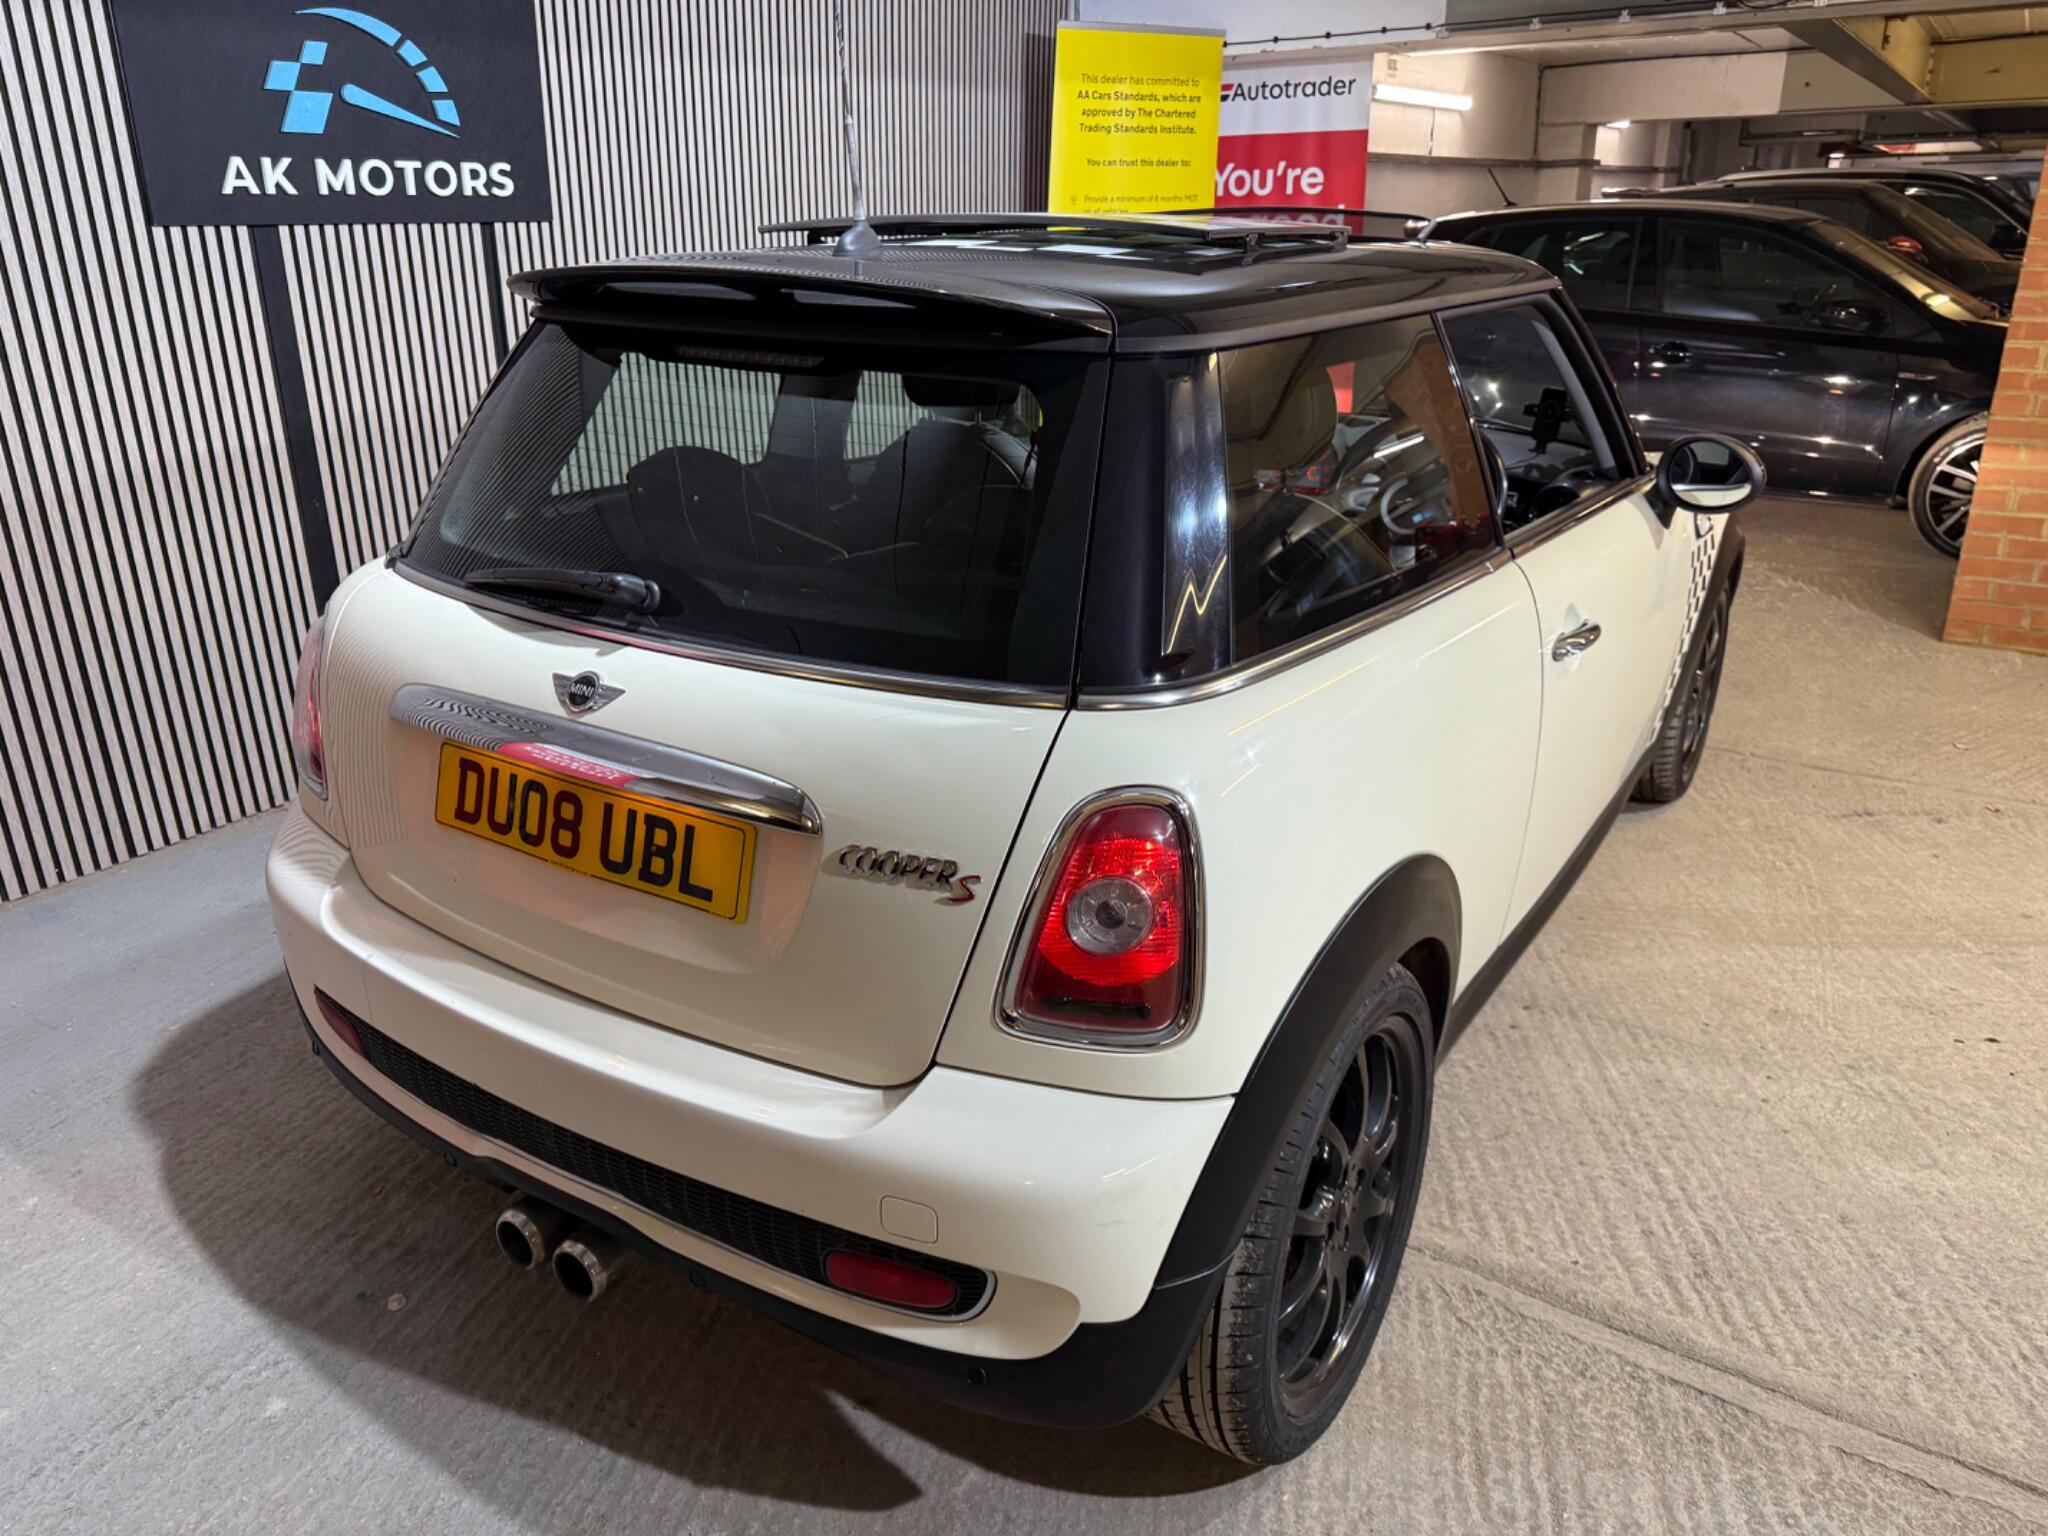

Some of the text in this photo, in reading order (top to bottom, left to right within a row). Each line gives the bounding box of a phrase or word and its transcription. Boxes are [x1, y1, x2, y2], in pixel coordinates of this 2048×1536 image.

[1081, 73, 1200, 87] This dealer has committed to
[1231, 75, 1356, 102] Autotrader
[1077, 90, 1201, 103] AA Cars Standards, which are
[1081, 108, 1196, 119] approved by The Chartered
[1079, 123, 1197, 135] Trading Standards Institute.
[1086, 158, 1101, 167] You
[1102, 159, 1117, 167] can
[1119, 158, 1138, 167] trust
[1139, 158, 1154, 167] this
[1155, 158, 1179, 167] dealer
[221, 155, 516, 198] AK MOTORS
[570, 682, 595, 698] MINI
[453, 756, 714, 903] DU08 UBL
[838, 844, 983, 903] COOPER S
